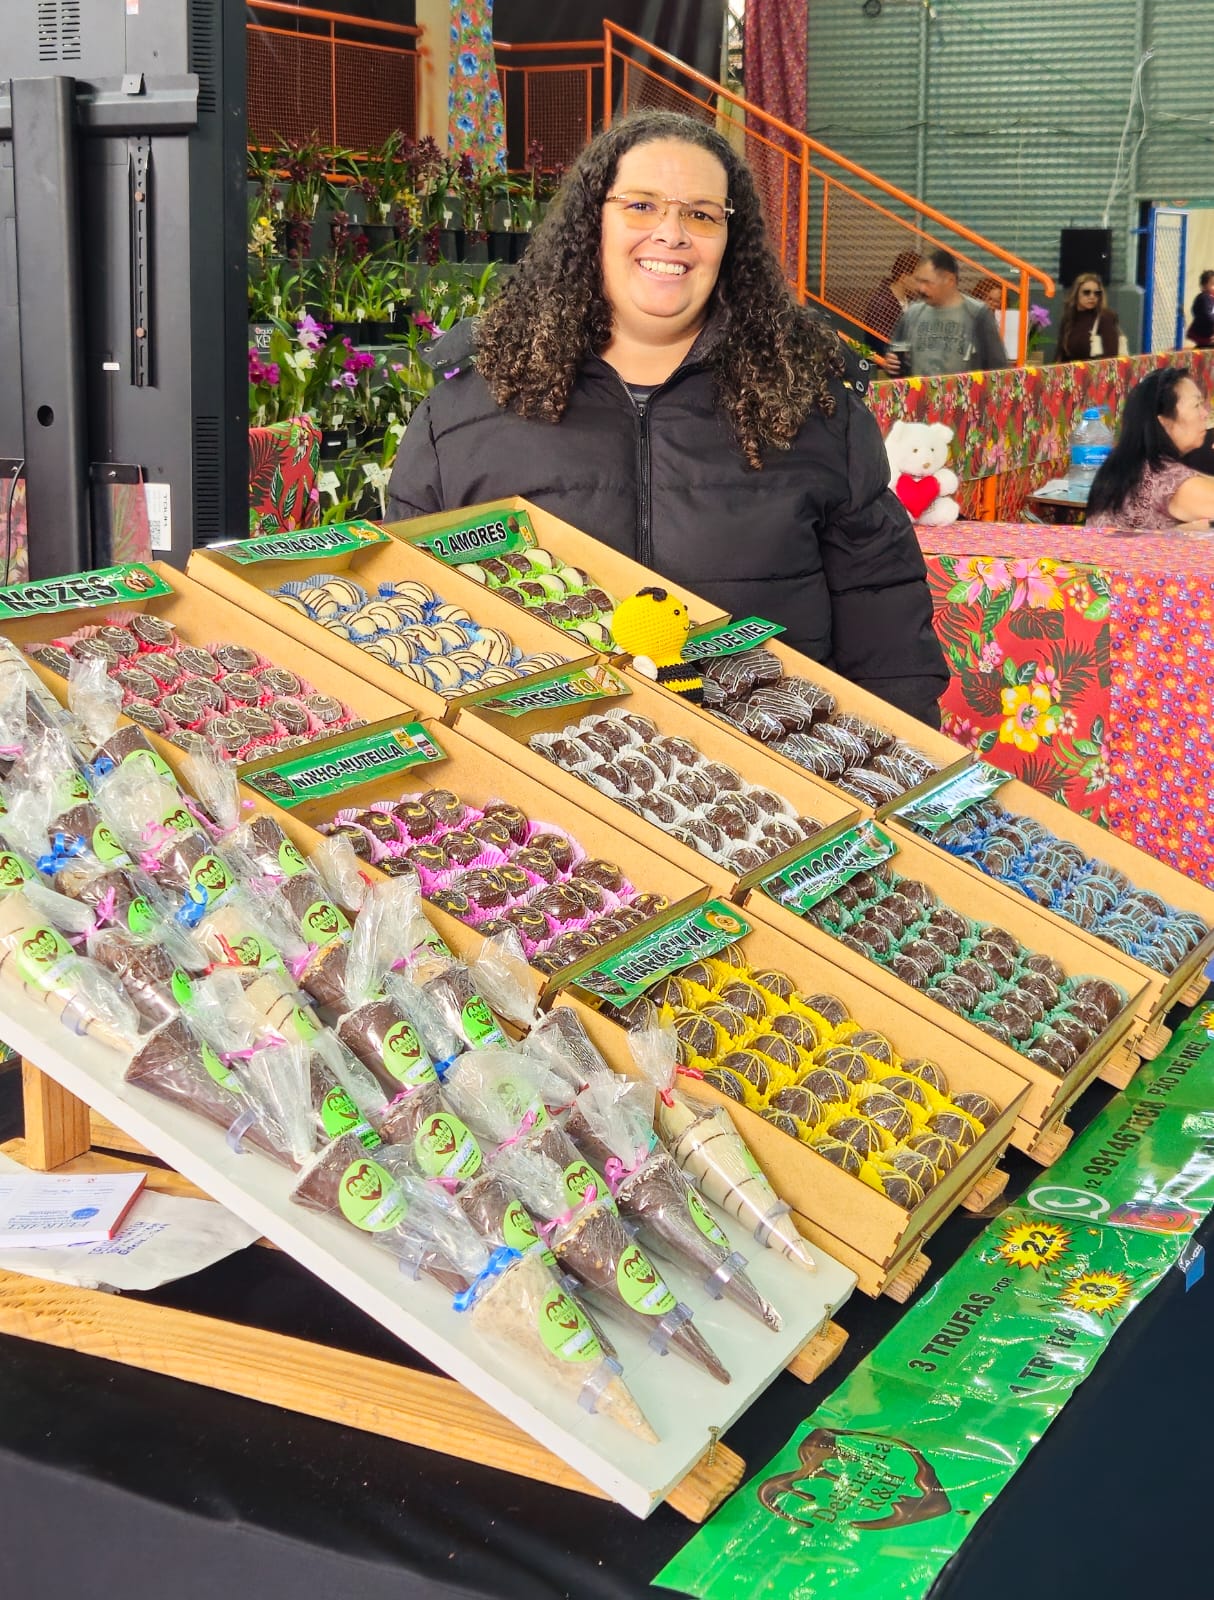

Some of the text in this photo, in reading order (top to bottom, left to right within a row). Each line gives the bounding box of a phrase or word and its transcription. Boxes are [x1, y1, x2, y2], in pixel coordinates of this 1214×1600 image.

[250, 528, 353, 557] MARACUJÁ
[435, 522, 507, 556] 2 AMORES
[2, 576, 119, 612] NOZES
[715, 633, 744, 648] DE
[733, 622, 775, 641] MEL
[290, 743, 407, 789] NINHO-NUTELLA
[615, 921, 716, 984] MARACUJÁ
[1147, 1040, 1211, 1097] PÃO DE MEL
[1084, 1178, 1102, 1190] 12
[1022, 1230, 1058, 1257] 22
[992, 1277, 1014, 1294] POR
[921, 1293, 996, 1356] TRUFAS
[1018, 1326, 1079, 1380] TRFA
[1079, 1281, 1118, 1298] 8
[909, 1358, 937, 1372] 3
[812, 1442, 894, 1523] Deliciaria
[858, 1472, 906, 1512] R&H
